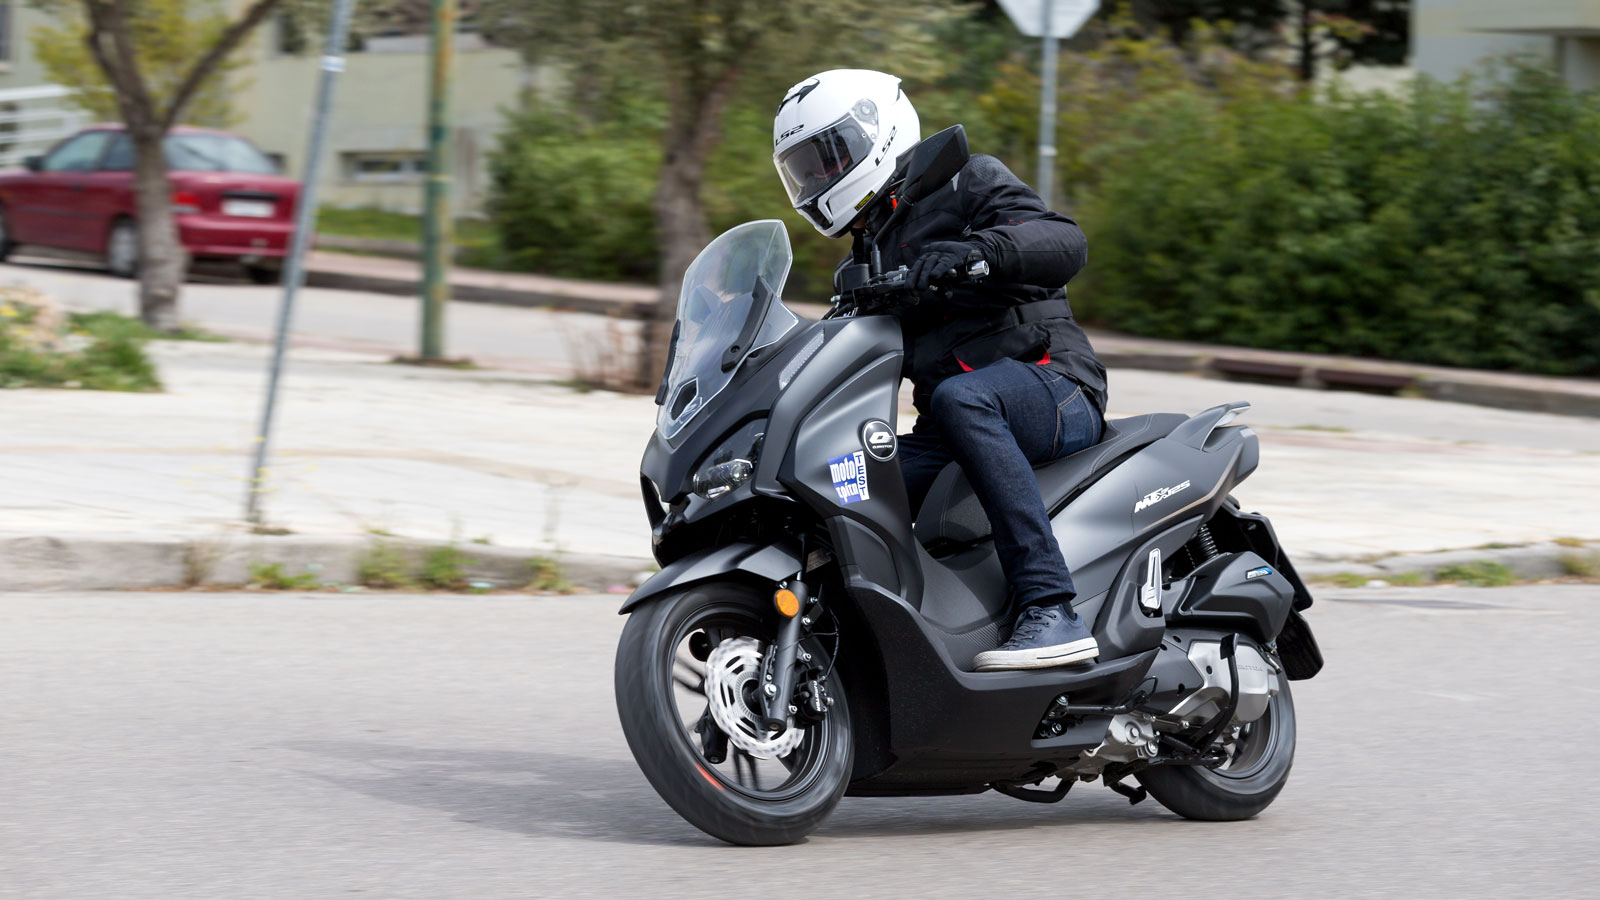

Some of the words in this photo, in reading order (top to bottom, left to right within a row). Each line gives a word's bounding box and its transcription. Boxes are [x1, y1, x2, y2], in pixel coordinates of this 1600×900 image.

[776, 124, 804, 146] LS2
[875, 125, 897, 167] LS2
[830, 457, 856, 483] moto
[855, 454, 865, 496] TEST
